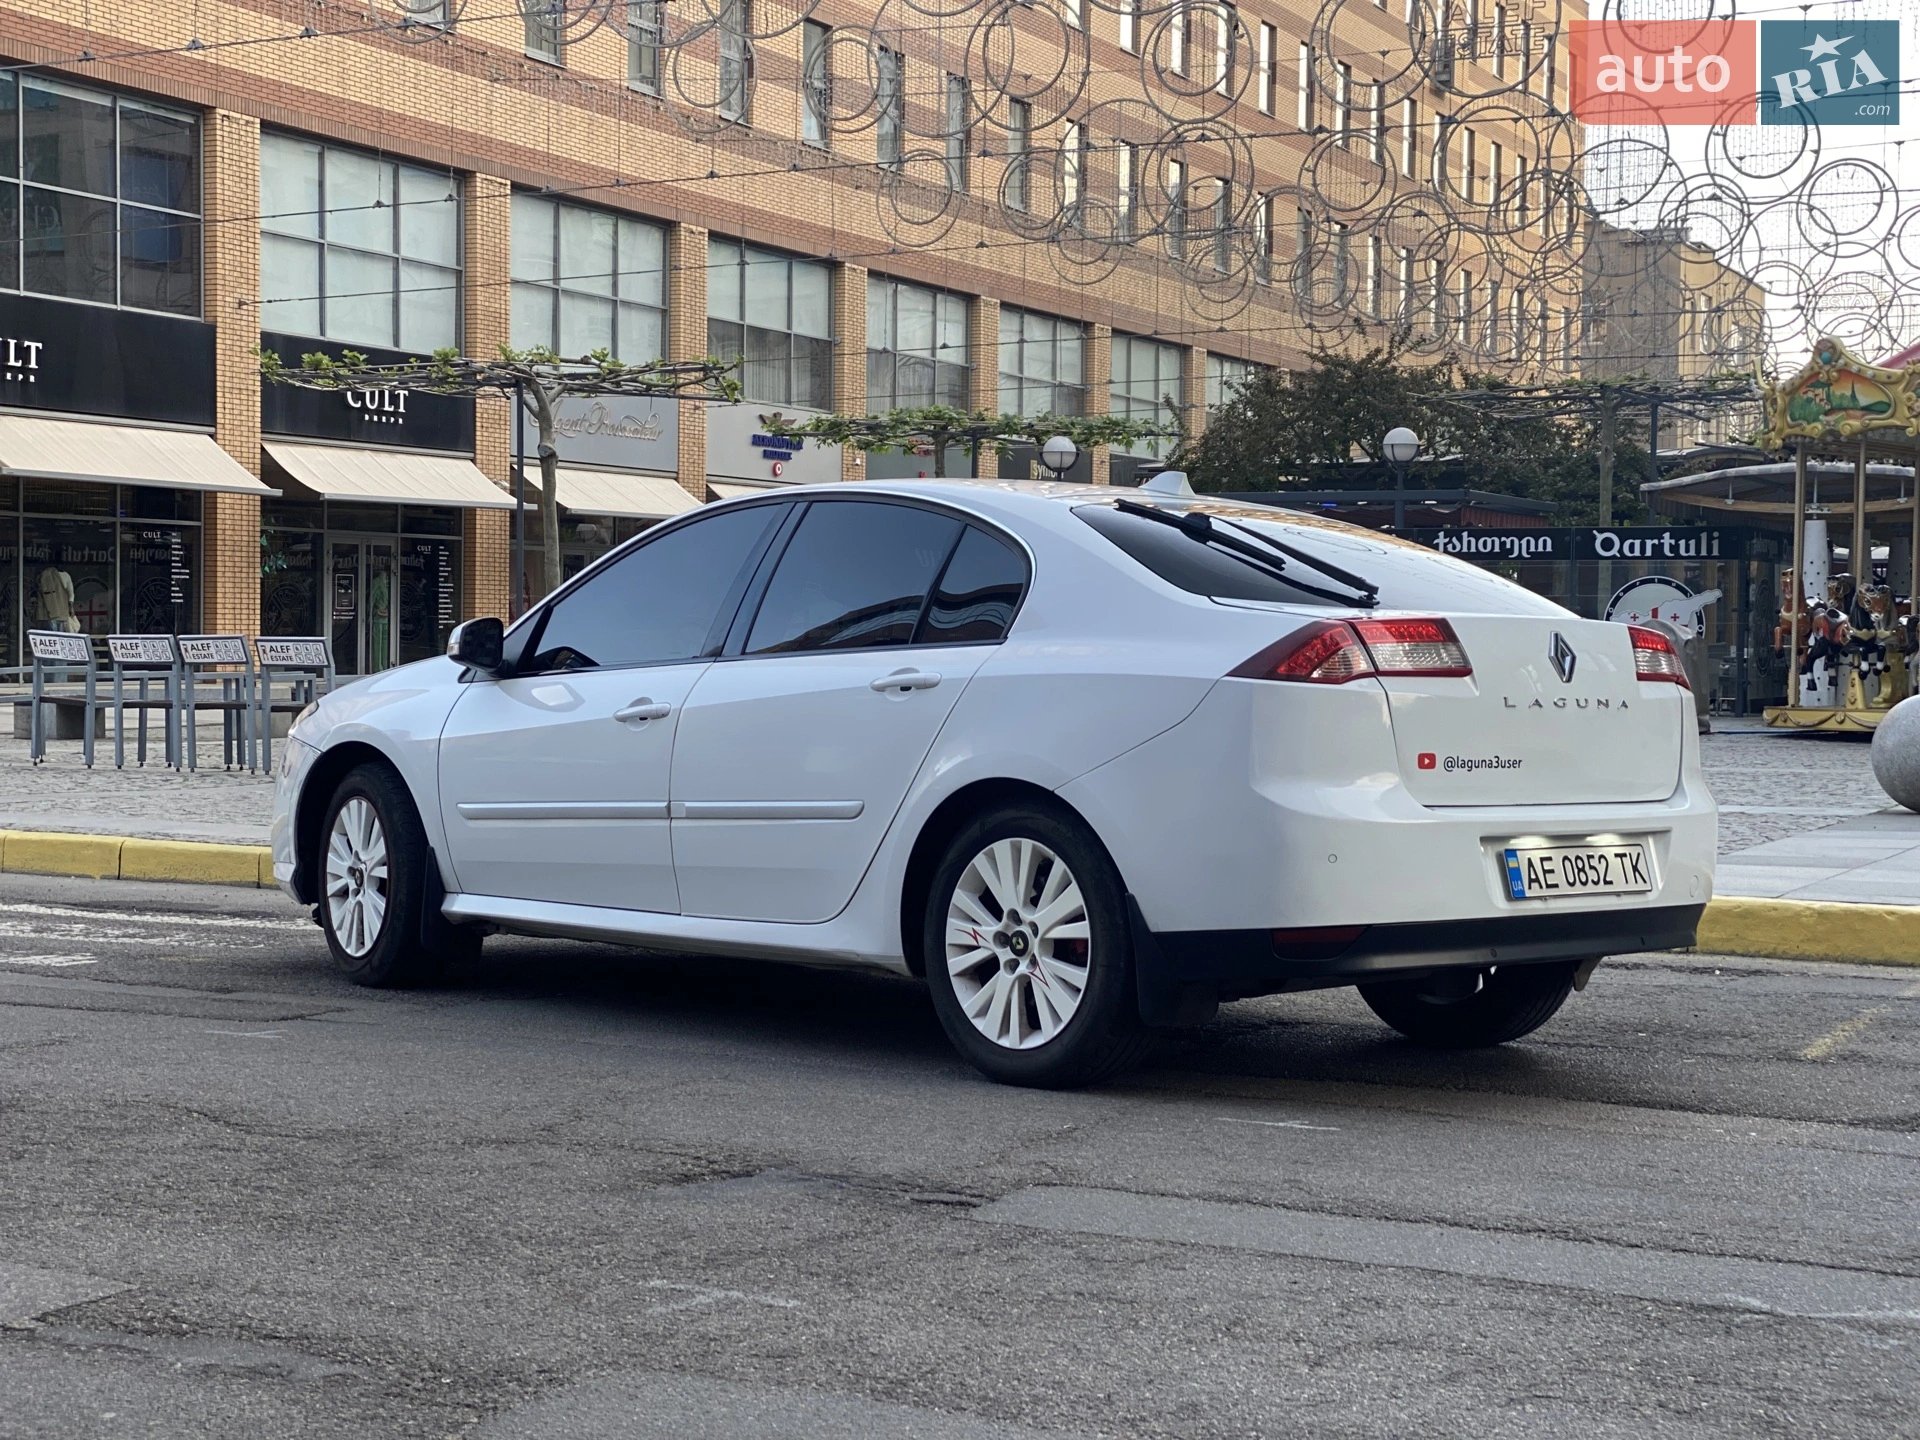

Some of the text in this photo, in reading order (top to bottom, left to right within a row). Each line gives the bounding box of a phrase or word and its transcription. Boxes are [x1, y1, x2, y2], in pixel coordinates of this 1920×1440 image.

[0, 337, 43, 369] LT
[346, 389, 409, 413] CULT
[143, 531, 161, 539] CULT
[1592, 529, 1720, 557] Qartuli
[39, 639, 58, 647] ALEF
[119, 642, 140, 650] ALEF
[190, 642, 211, 651] ALEF
[40, 648, 60, 656] ESTATE
[269, 645, 291, 653] ALEF
[191, 652, 215, 660] ESTATE
[1503, 696, 1629, 710] LAGUNA
[1443, 755, 1523, 773] @laguna3user
[1527, 852, 1648, 890] AE 0852 TK
[1512, 880, 1524, 891] UA
